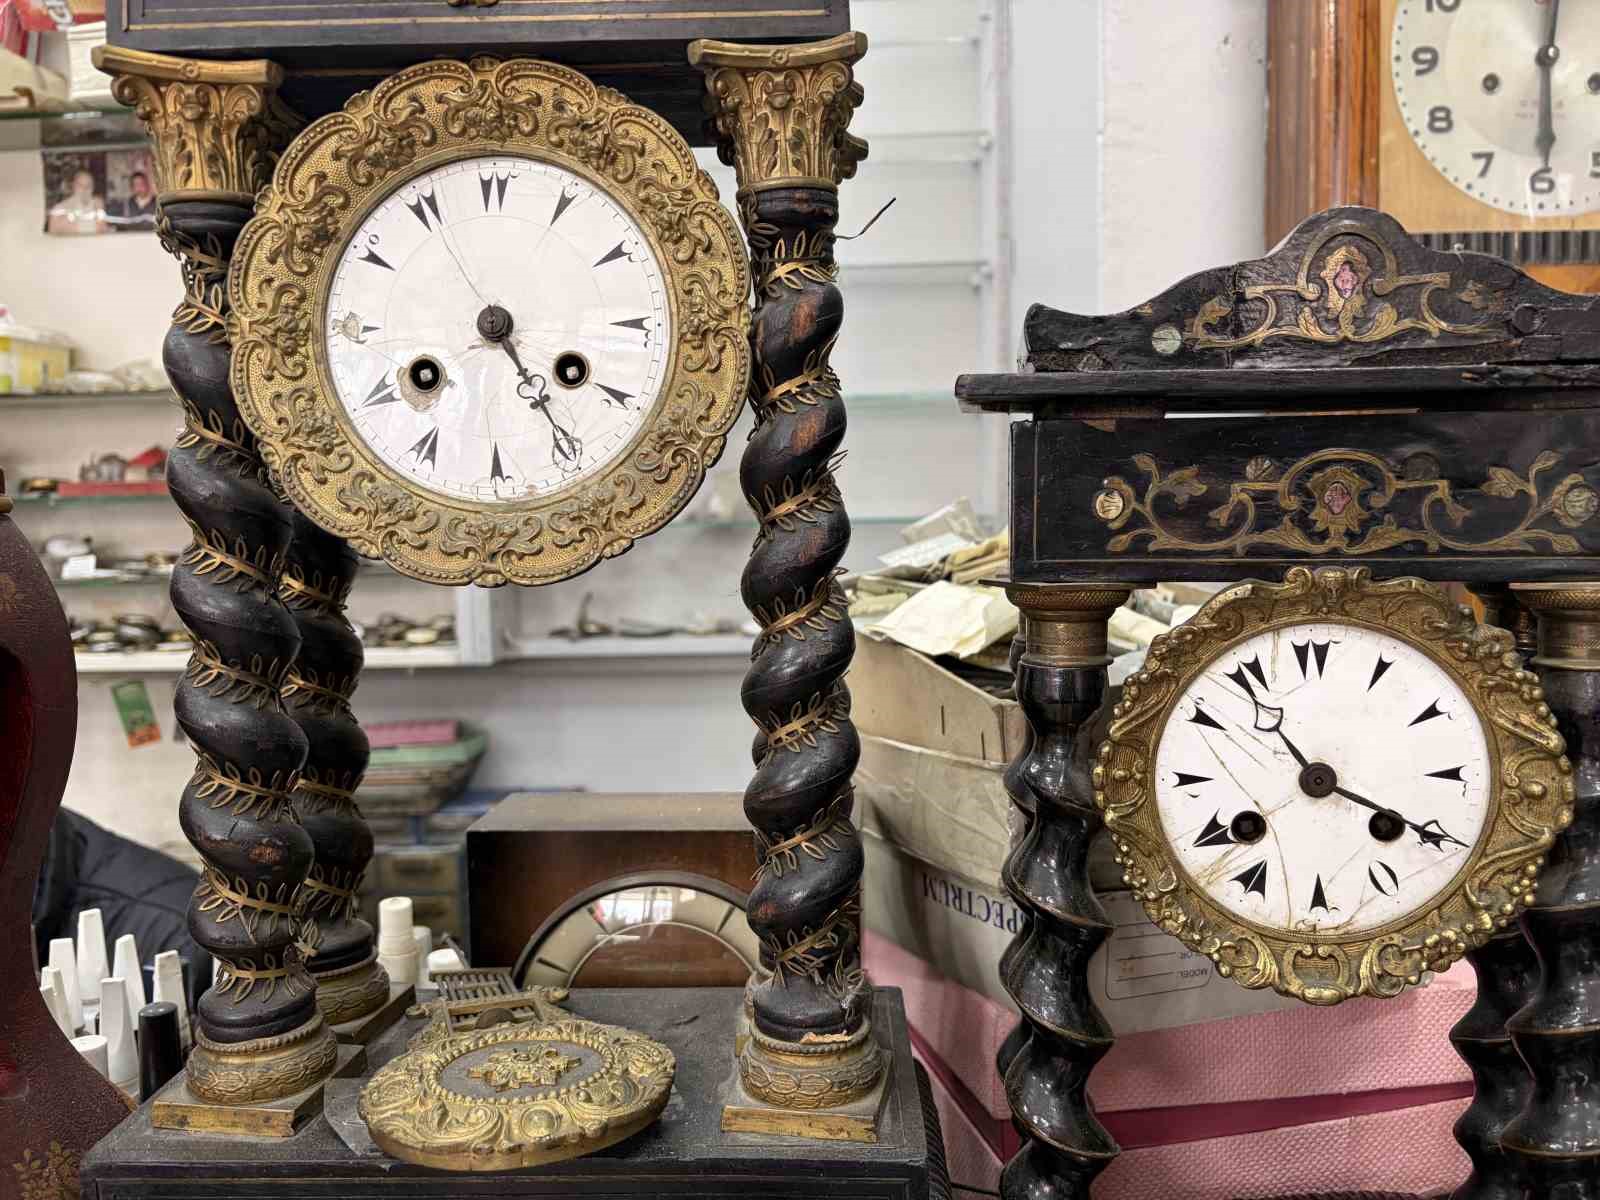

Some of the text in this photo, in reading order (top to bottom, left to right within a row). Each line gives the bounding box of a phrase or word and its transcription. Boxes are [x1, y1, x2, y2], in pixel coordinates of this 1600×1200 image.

[1412, 46, 1439, 76] 9
[1428, 106, 1453, 134] 8
[1471, 152, 1495, 178] 7
[1530, 167, 1555, 194] 6
